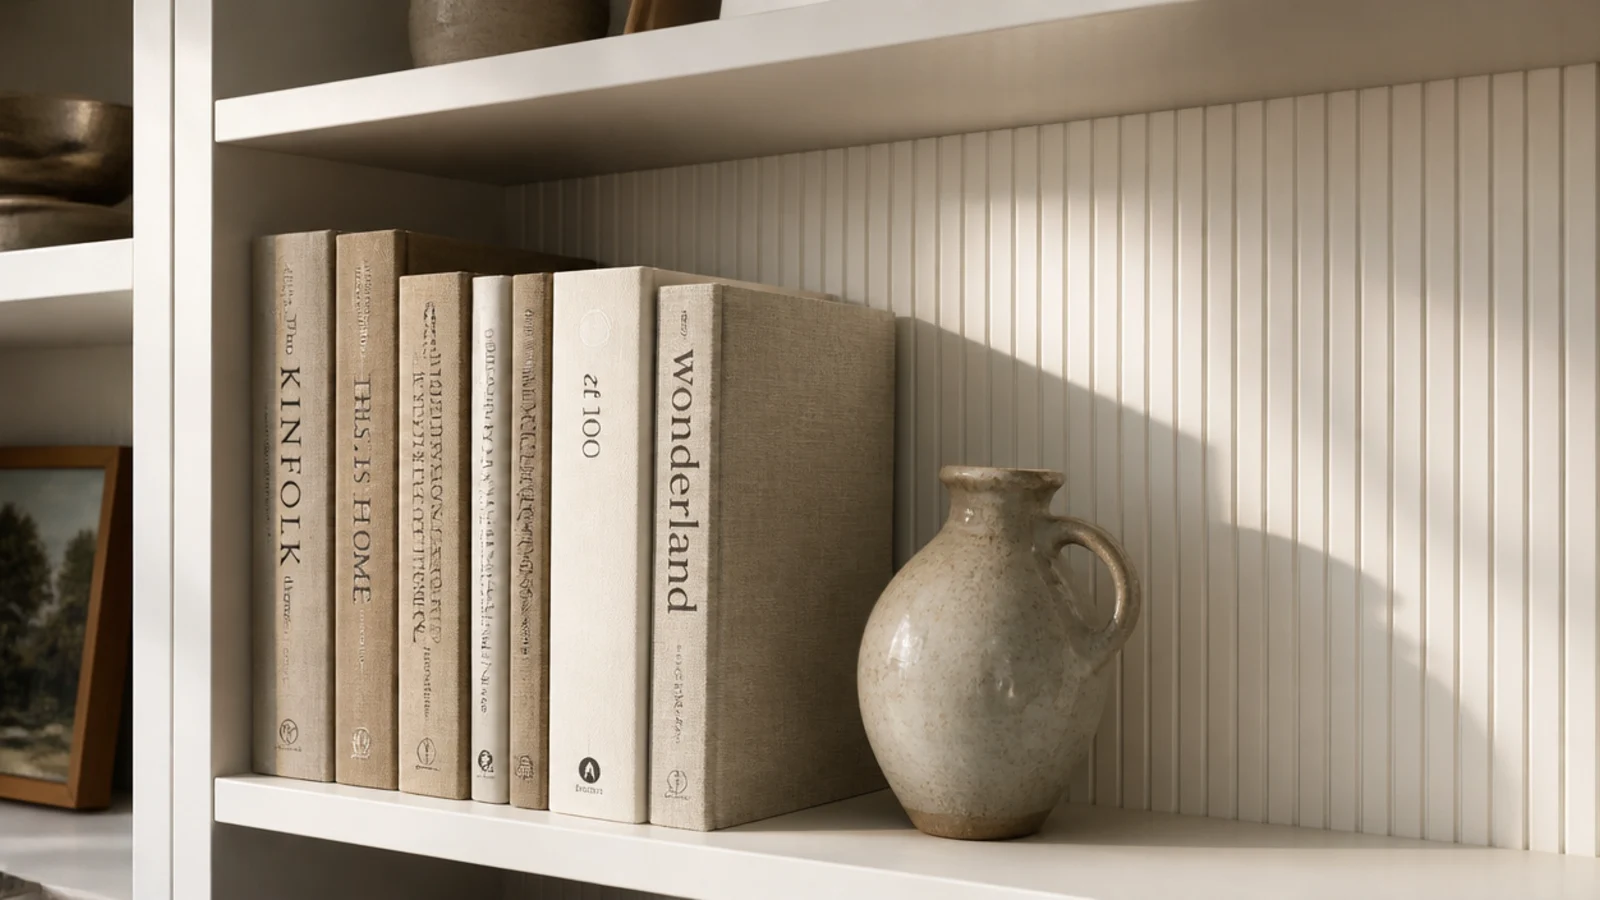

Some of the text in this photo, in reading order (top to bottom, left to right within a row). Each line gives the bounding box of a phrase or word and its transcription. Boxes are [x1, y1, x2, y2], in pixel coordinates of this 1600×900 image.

[279, 366, 302, 566] KINFOLK
[352, 494, 371, 605] HOME
[667, 349, 699, 614] wonderland
